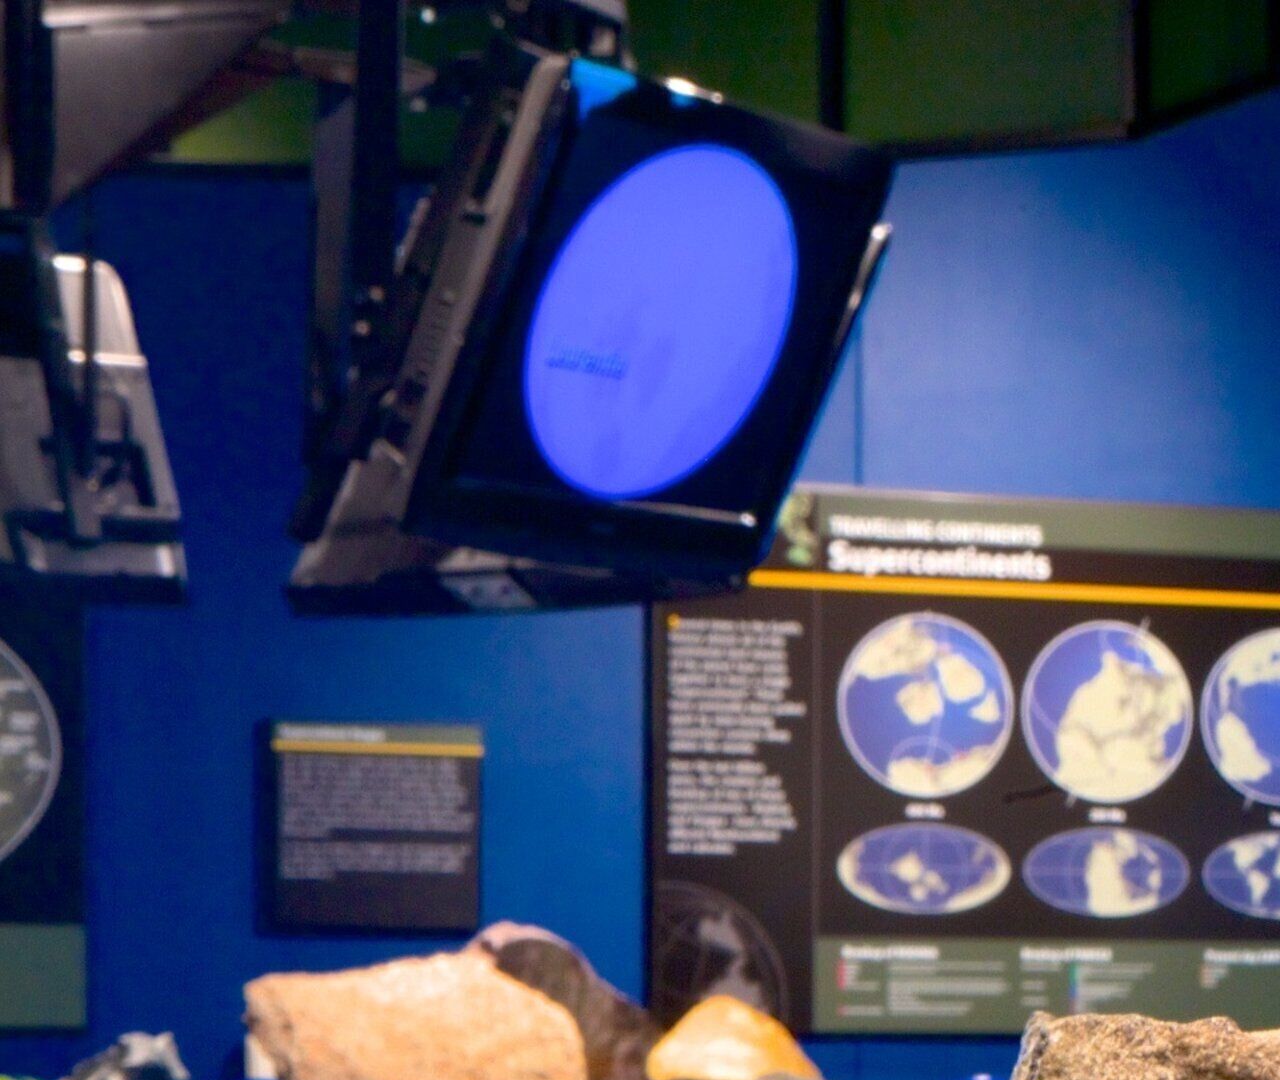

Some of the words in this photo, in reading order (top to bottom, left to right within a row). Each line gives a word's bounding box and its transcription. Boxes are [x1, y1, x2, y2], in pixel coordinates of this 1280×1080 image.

[829, 515, 935, 541] TRAVELLING
[936, 520, 1043, 547] CONTINENTS
[828, 539, 1052, 580] Supercontinents
